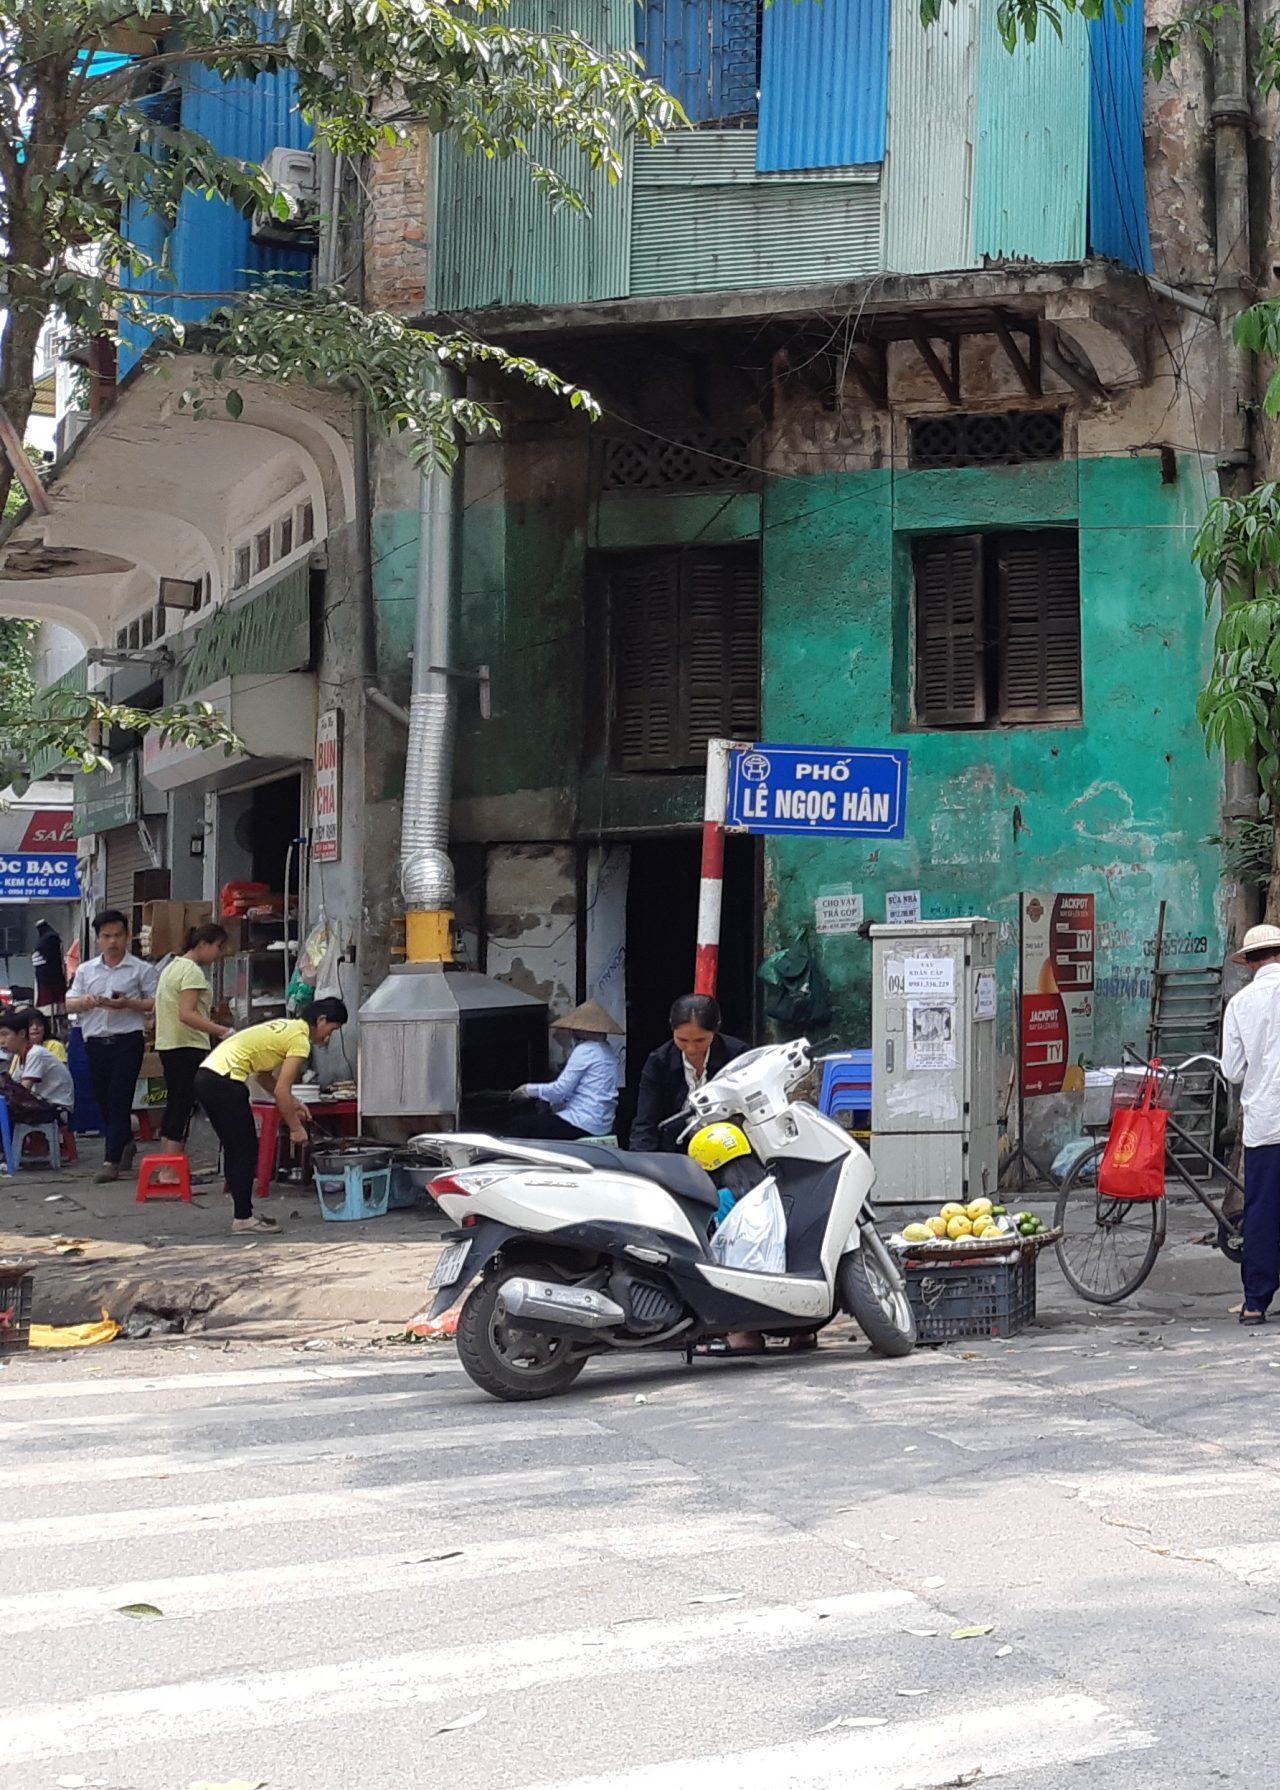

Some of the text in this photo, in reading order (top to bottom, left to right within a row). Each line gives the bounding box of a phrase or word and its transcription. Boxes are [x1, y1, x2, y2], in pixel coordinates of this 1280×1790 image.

[795, 758, 852, 781] PHỐ
[743, 782, 889, 826] LÊ NGỌC HÂN
[26, 861, 68, 877] BẠC
[4, 878, 25, 887] KEM
[48, 878, 71, 889] LOẠI
[822, 897, 857, 907] CHO VAY
[1061, 898, 1089, 909] JACKPOT
[1030, 1009, 1059, 1022] JACKPOT
